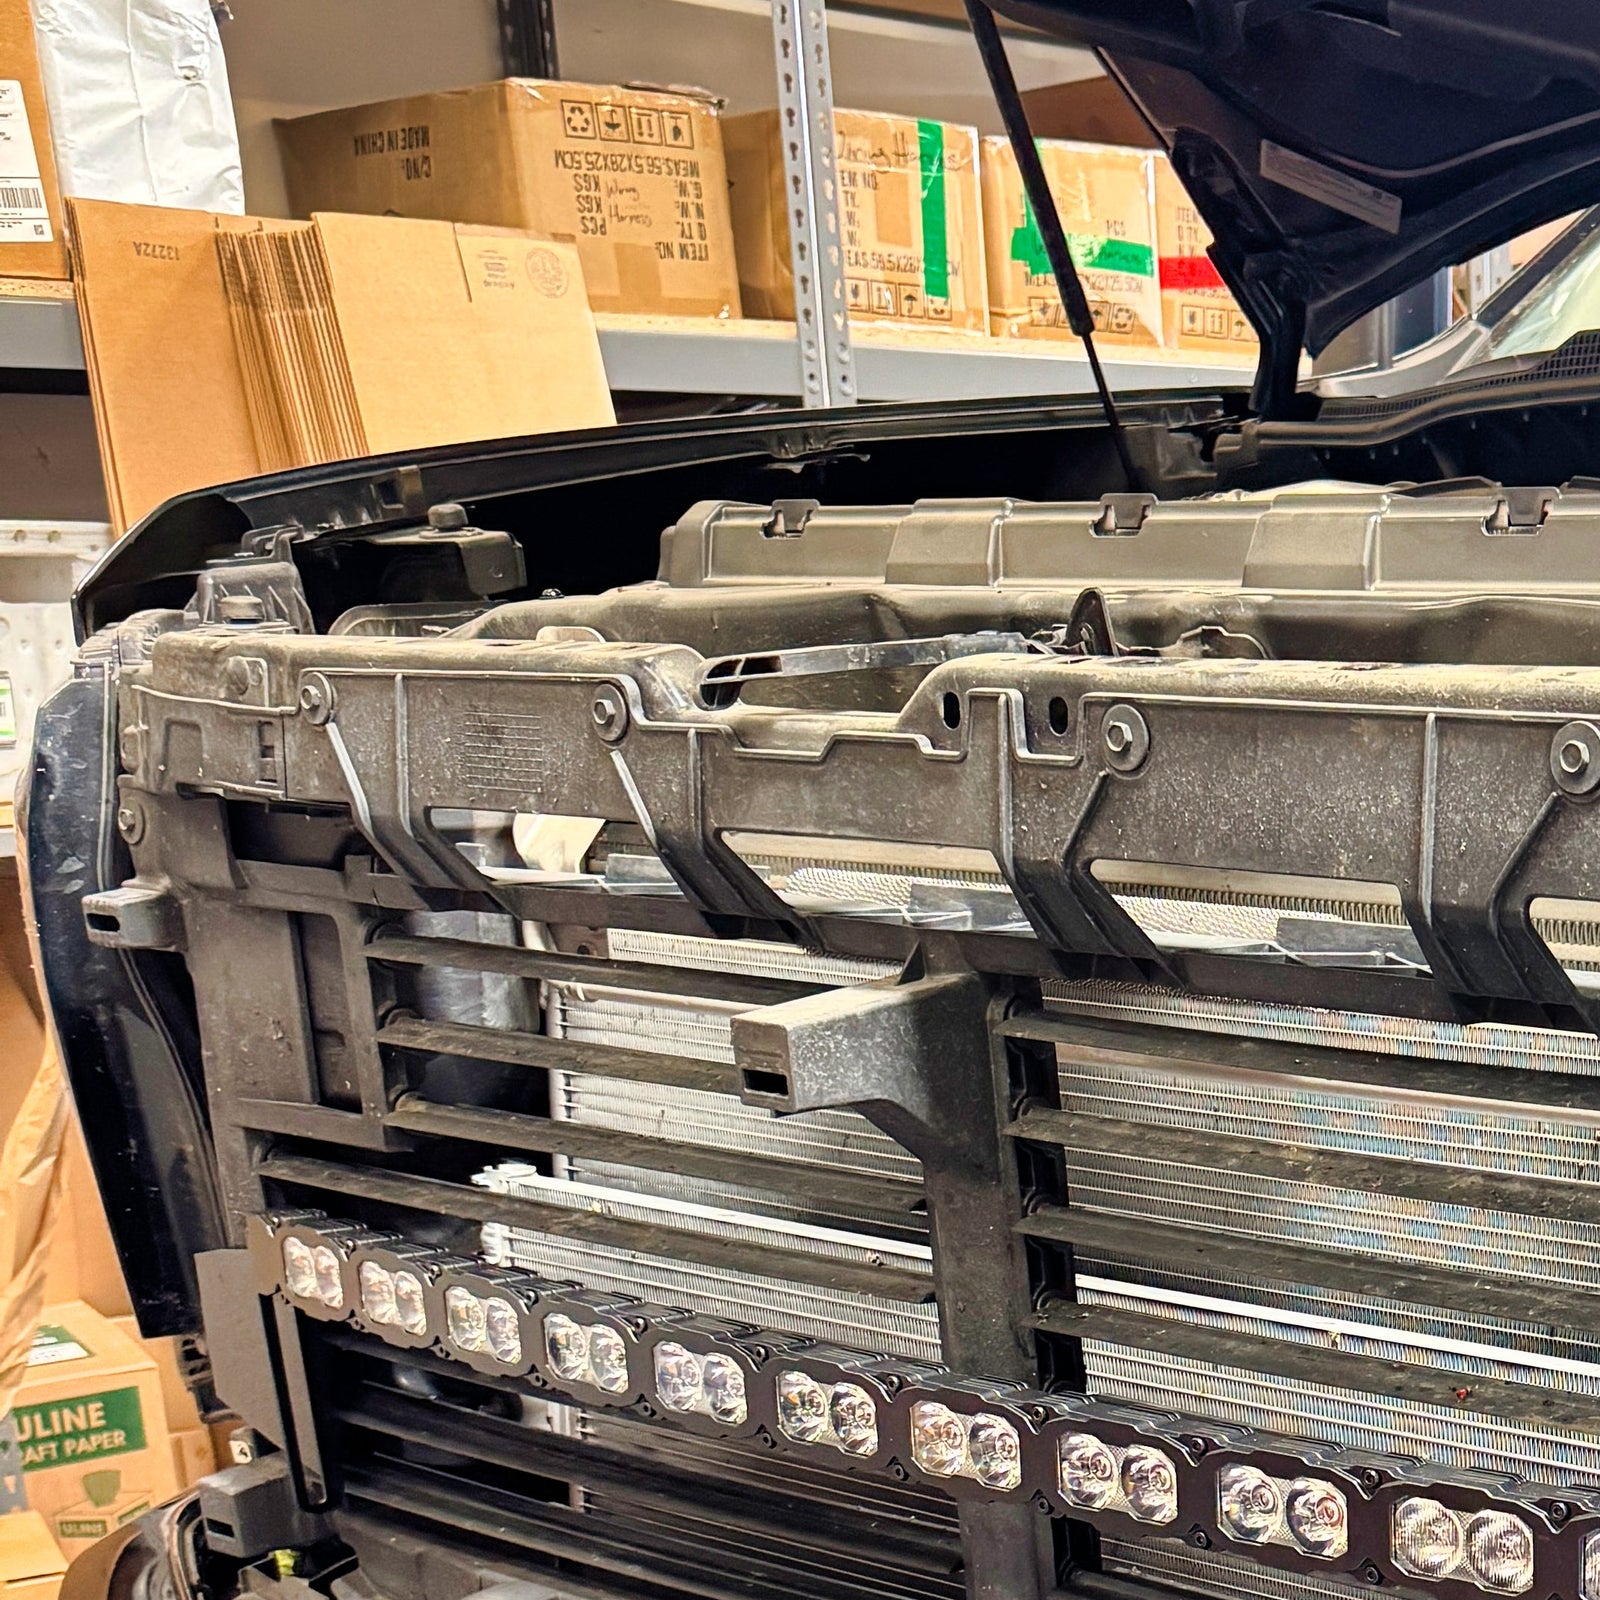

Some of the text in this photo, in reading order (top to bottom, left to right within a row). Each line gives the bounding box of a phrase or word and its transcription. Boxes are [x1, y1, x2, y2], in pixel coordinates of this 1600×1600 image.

[353, 131, 385, 157] CHINA
[573, 173, 601, 193] KGS
[575, 194, 603, 214] KGS
[580, 215, 607, 236] PCS
[132, 241, 180, 261] 13272A
[679, 242, 709, 261] ITEM
[14, 1401, 107, 1441] ULINE
[24, 1428, 127, 1464] AFT PAPER
